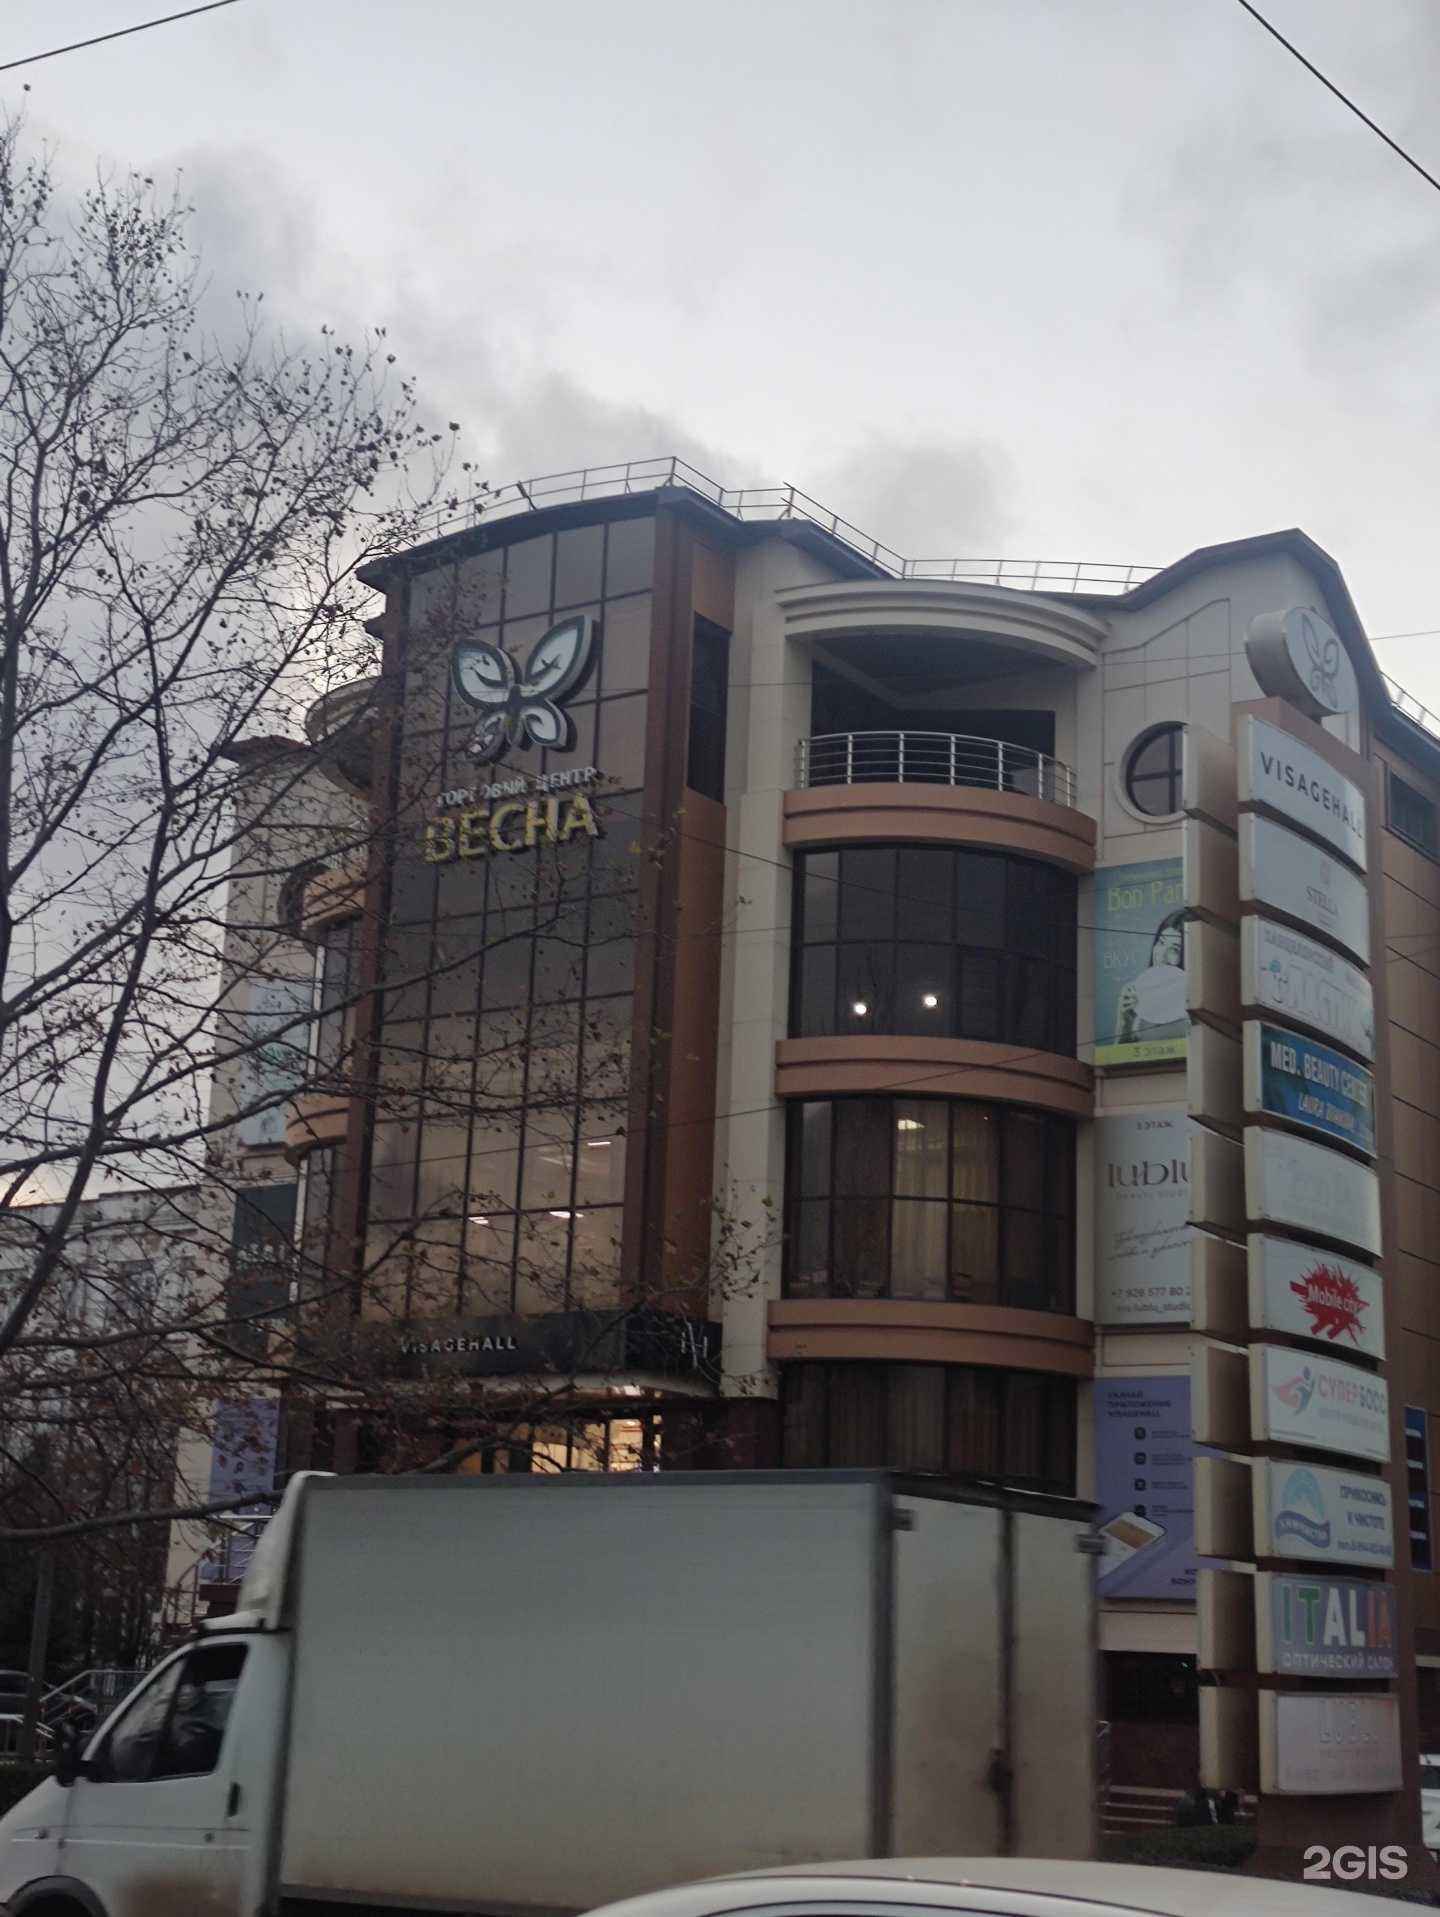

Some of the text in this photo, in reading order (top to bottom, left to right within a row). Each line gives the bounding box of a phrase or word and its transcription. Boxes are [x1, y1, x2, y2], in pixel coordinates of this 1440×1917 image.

[423, 792, 599, 865] ВЕСНА
[1280, 1582, 1393, 1648] ITALIA
[1281, 1650, 1364, 1669] ОПТИЧЕСКИЙ
